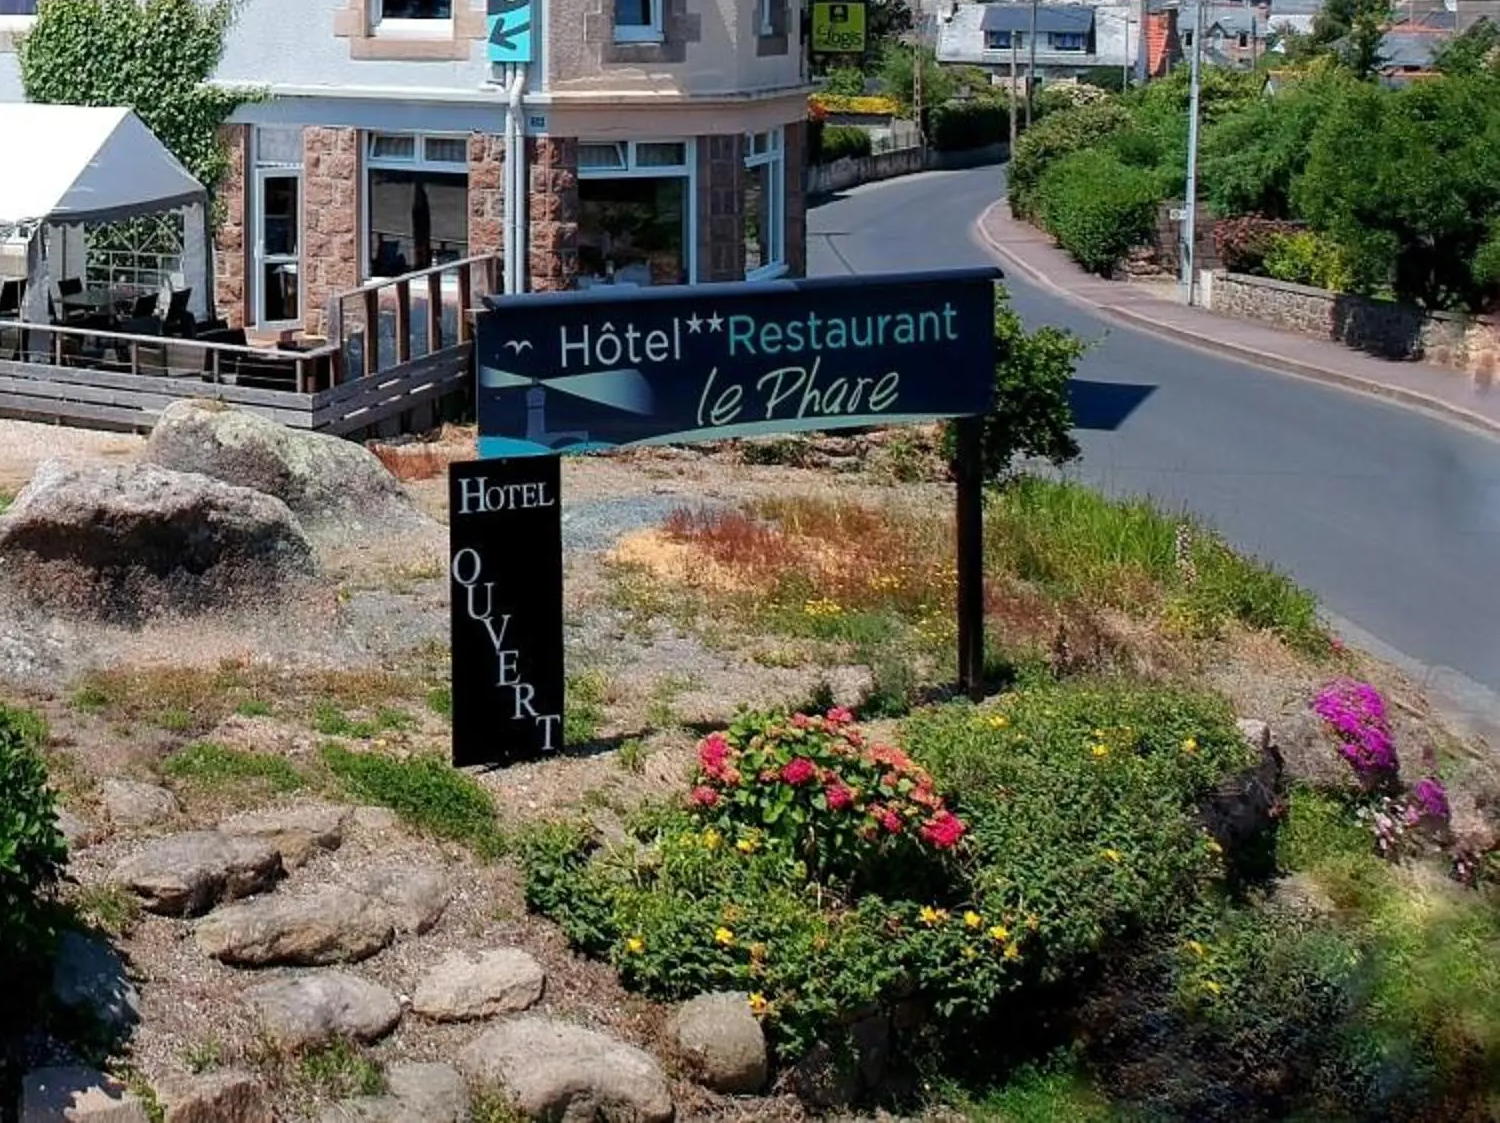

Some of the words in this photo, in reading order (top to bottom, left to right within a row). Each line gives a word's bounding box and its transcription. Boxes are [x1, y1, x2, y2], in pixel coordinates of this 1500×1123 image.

[560, 317, 681, 368] Hôtel
[728, 301, 959, 357] Restaurant
[756, 355, 900, 420] Phare
[457, 476, 555, 514] HOTEL
[452, 547, 561, 751] OUVERT
